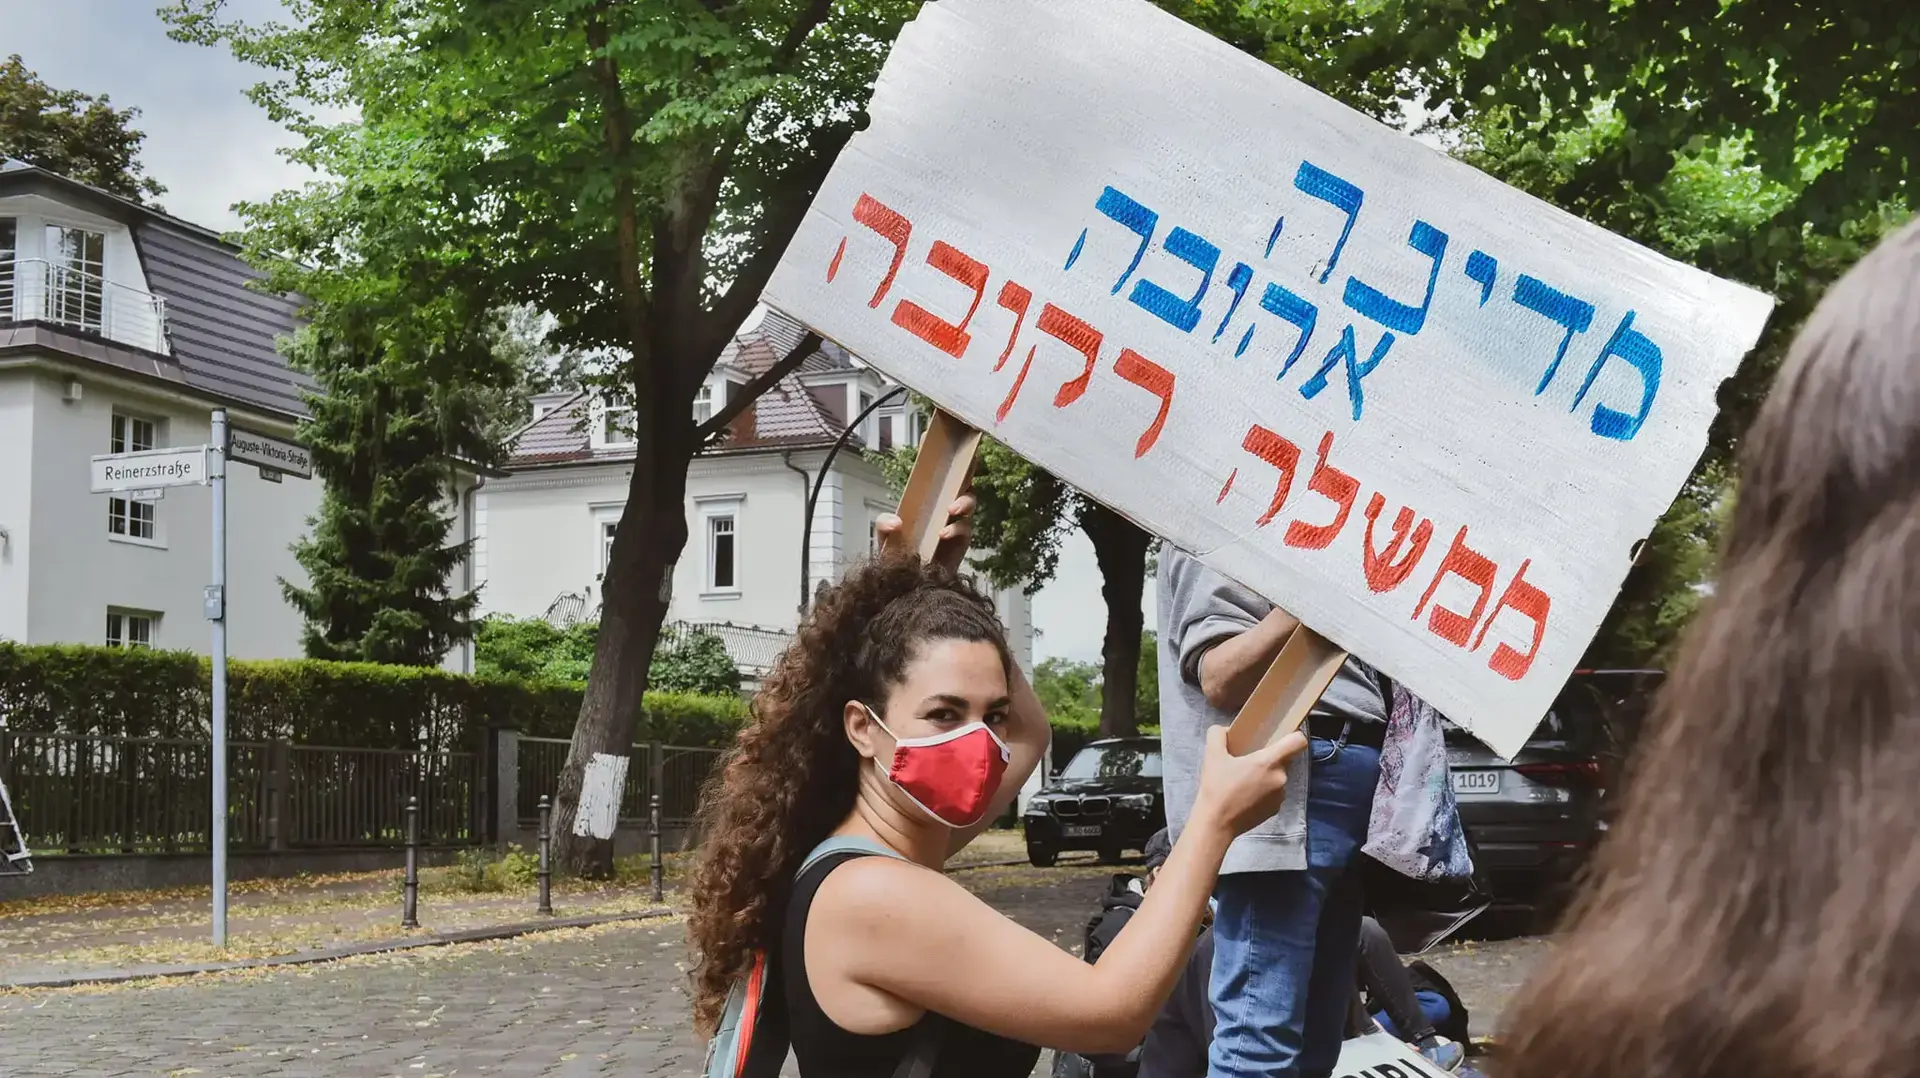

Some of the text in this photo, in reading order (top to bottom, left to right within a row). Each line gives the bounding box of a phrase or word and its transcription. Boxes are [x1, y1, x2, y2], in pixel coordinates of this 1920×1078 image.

[1063, 185, 1397, 421] אהובה
[1265, 160, 1664, 442] מדינה
[105, 460, 191, 480] Reinerzstraße
[231, 434, 308, 468] Auguste-Viktoria-Straße
[828, 193, 1551, 681] ממשלה רקובה
[1459, 773, 1496, 788] 1019
